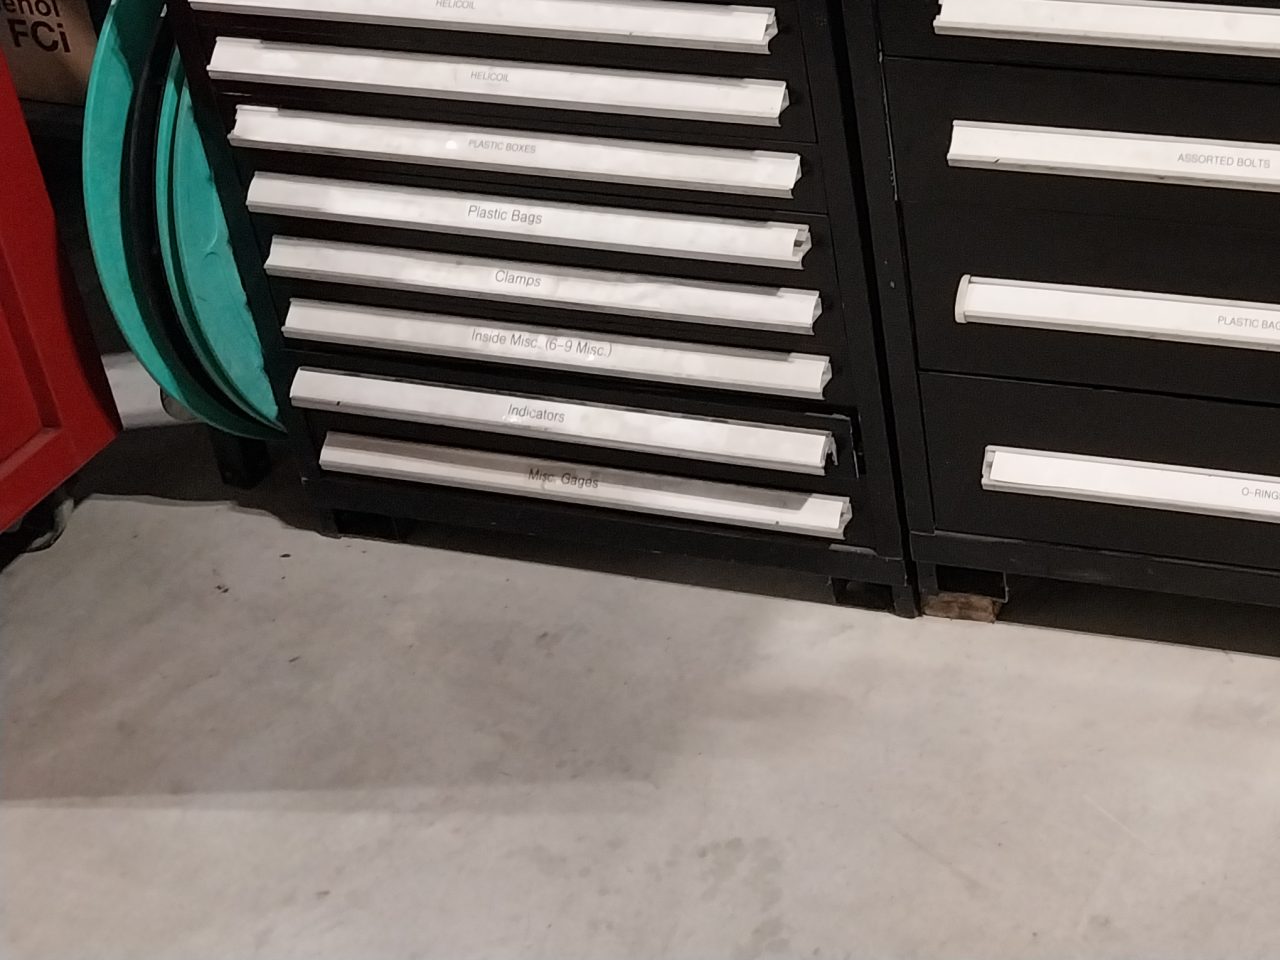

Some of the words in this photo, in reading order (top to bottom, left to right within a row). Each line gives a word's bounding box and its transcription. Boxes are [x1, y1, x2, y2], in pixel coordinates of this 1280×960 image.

[435, 0, 476, 9] HELICOIL
[7, 19, 71, 53] FCi
[471, 71, 509, 82] HELICOIL
[468, 139, 504, 150] PLASTIC
[506, 143, 536, 154] BOXES
[1177, 153, 1234, 166] ASSORTED
[1236, 158, 1271, 169] BOLTS
[467, 205, 508, 220] Plastic
[511, 209, 543, 225] Bags
[495, 269, 542, 287] Clamps
[1217, 315, 1260, 328] PLASTIC
[471, 329, 507, 344] Inside
[507, 404, 566, 423] Indicators
[560, 472, 599, 489] Gages
